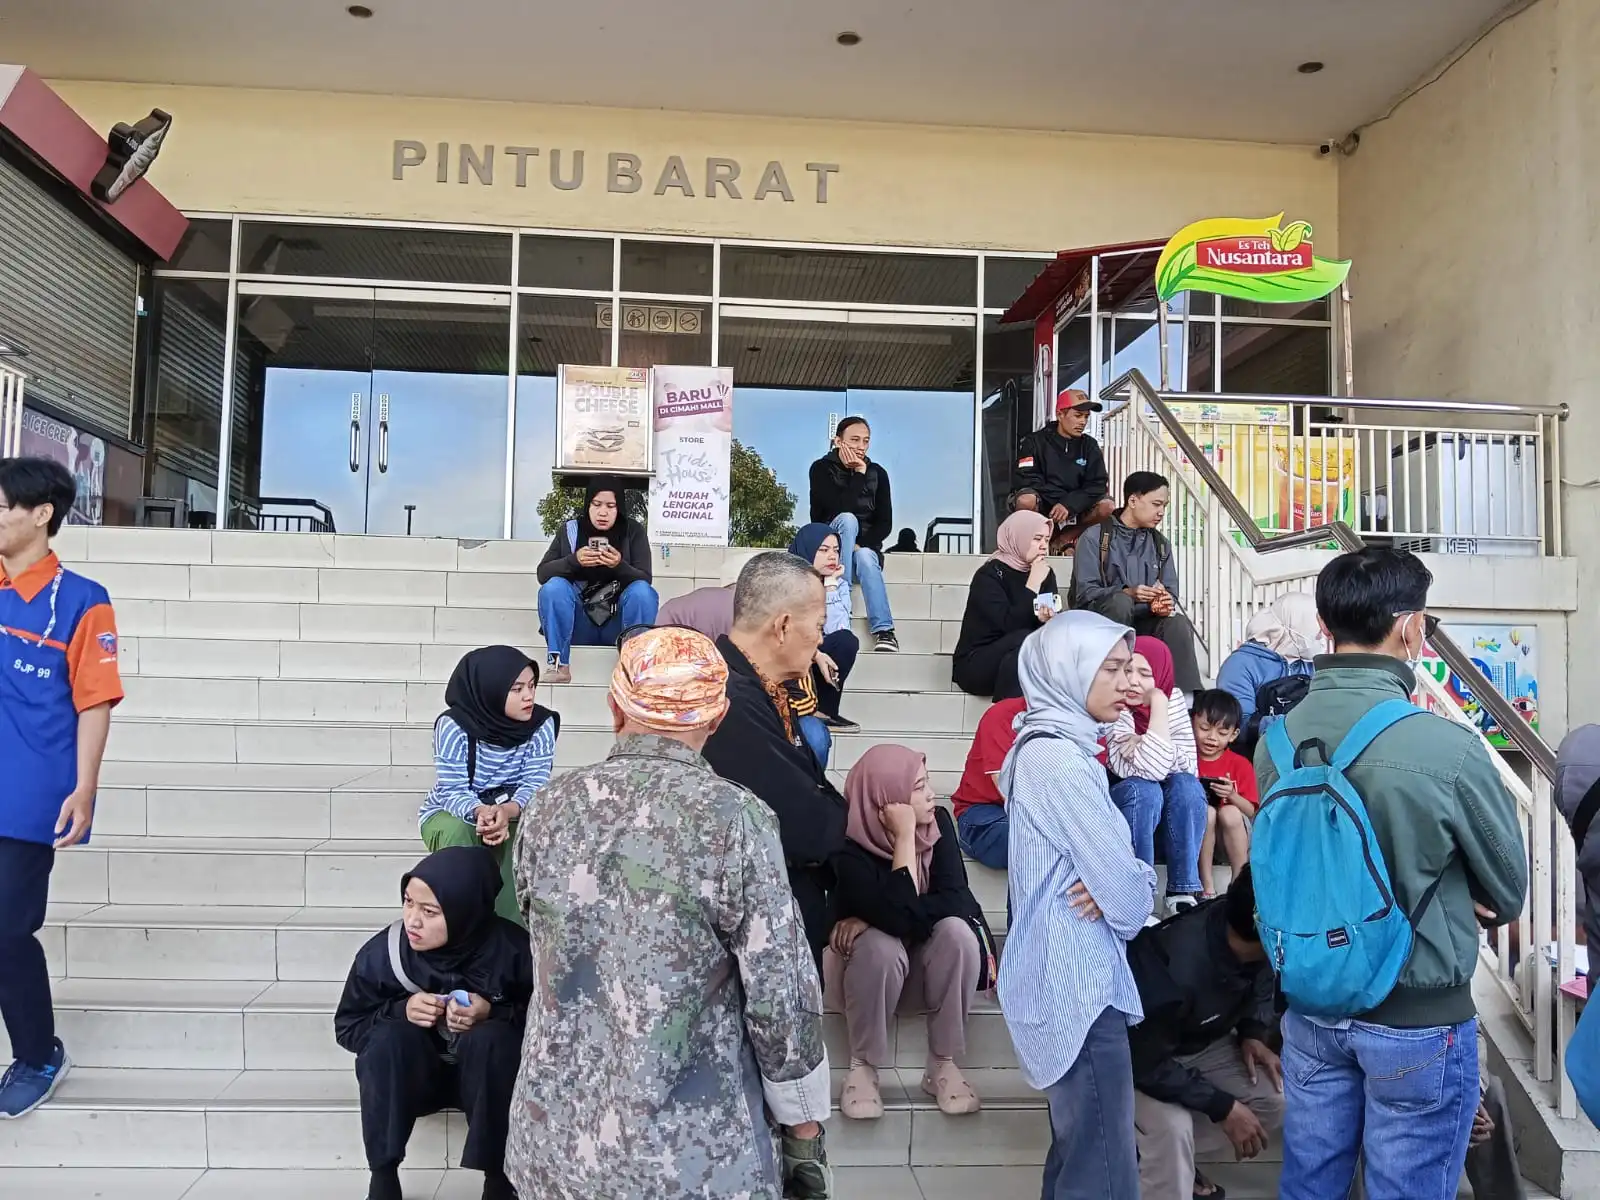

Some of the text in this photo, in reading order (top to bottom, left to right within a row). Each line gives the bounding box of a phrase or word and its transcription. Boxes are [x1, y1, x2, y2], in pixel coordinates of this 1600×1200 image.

[392, 139, 840, 204] PINTU BARAT
[1238, 240, 1270, 251] Es Teh
[1207, 247, 1304, 266] Nusantara
[574, 383, 640, 399] DOUBLE
[666, 387, 713, 404] BARU
[574, 398, 640, 415] CHEESE
[659, 401, 722, 415] DI CIMAHI MALL
[679, 436, 705, 444] STORE
[668, 490, 709, 500] MURAH
[663, 501, 714, 510] LENGKAP
[662, 510, 714, 520] ORIGINAL
[13, 658, 51, 678] SJP 99
